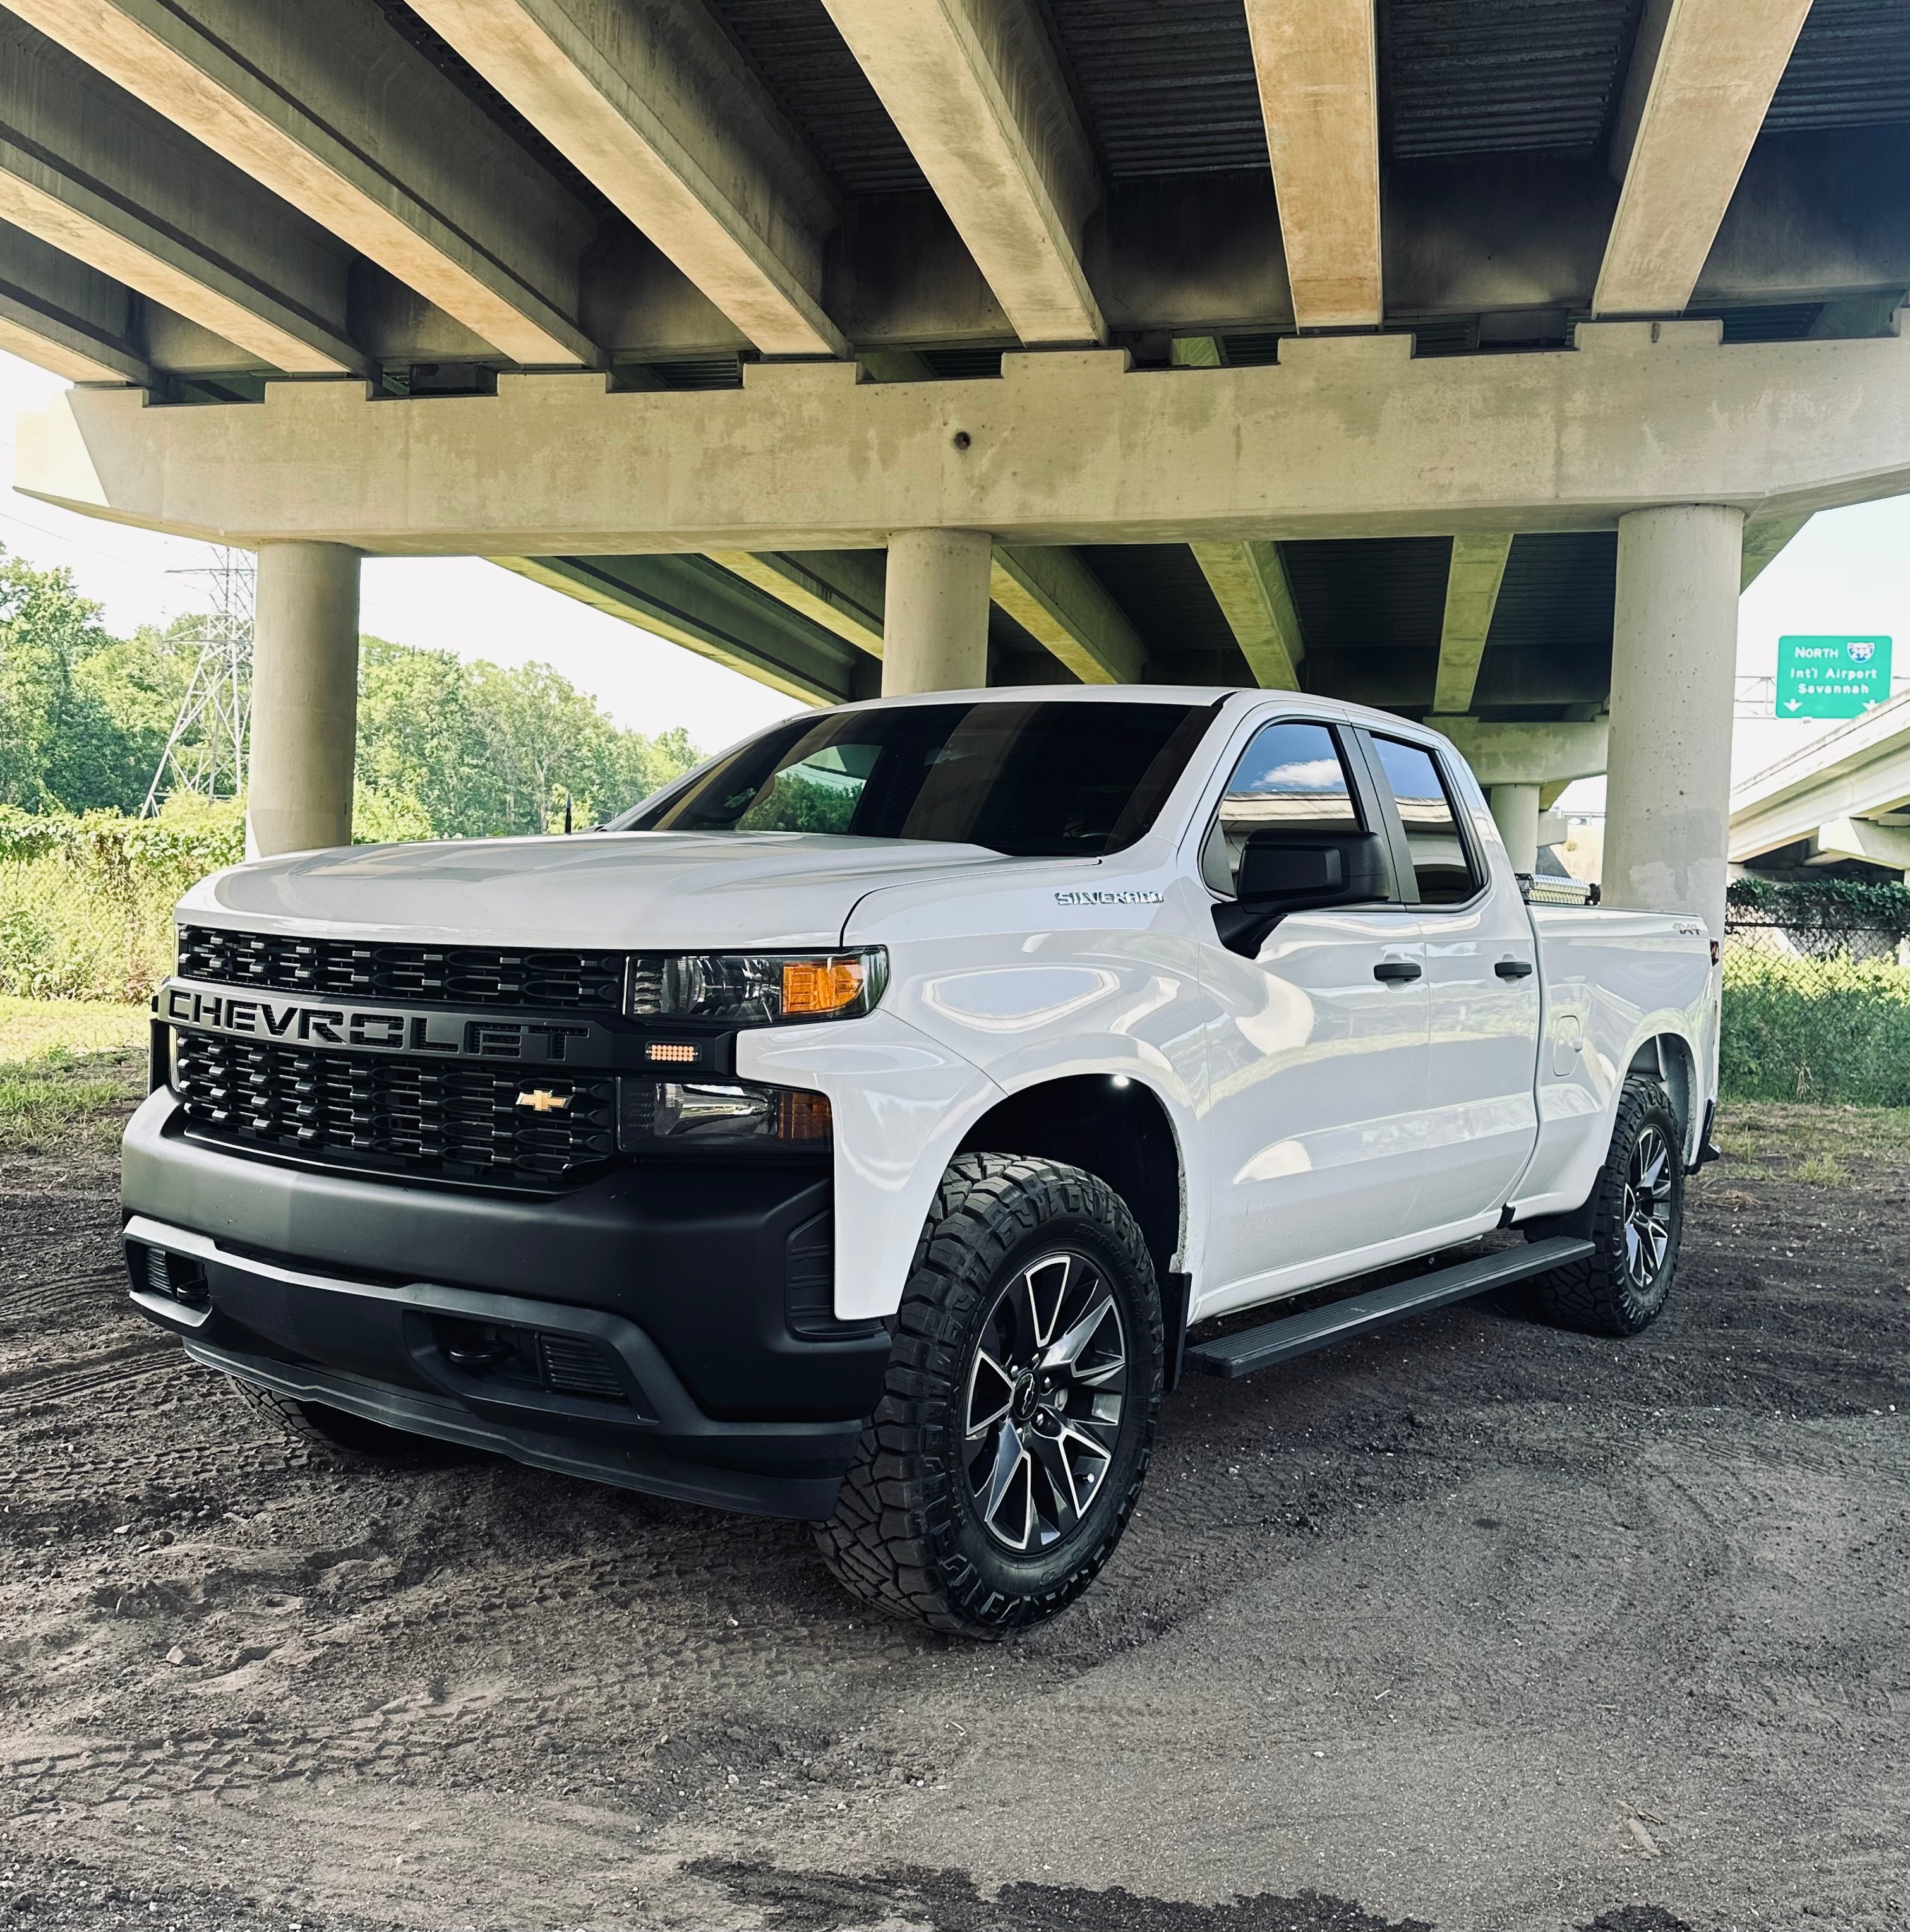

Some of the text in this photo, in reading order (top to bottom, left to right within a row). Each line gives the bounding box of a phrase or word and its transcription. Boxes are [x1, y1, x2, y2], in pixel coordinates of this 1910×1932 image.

[1795, 646, 1871, 658] NORTH 295
[1790, 667, 1878, 680] Int'l Airport
[1798, 683, 1870, 694] Savannah
[1055, 891, 1165, 906] SILVERADO
[168, 989, 591, 1061] CHEVROLET
